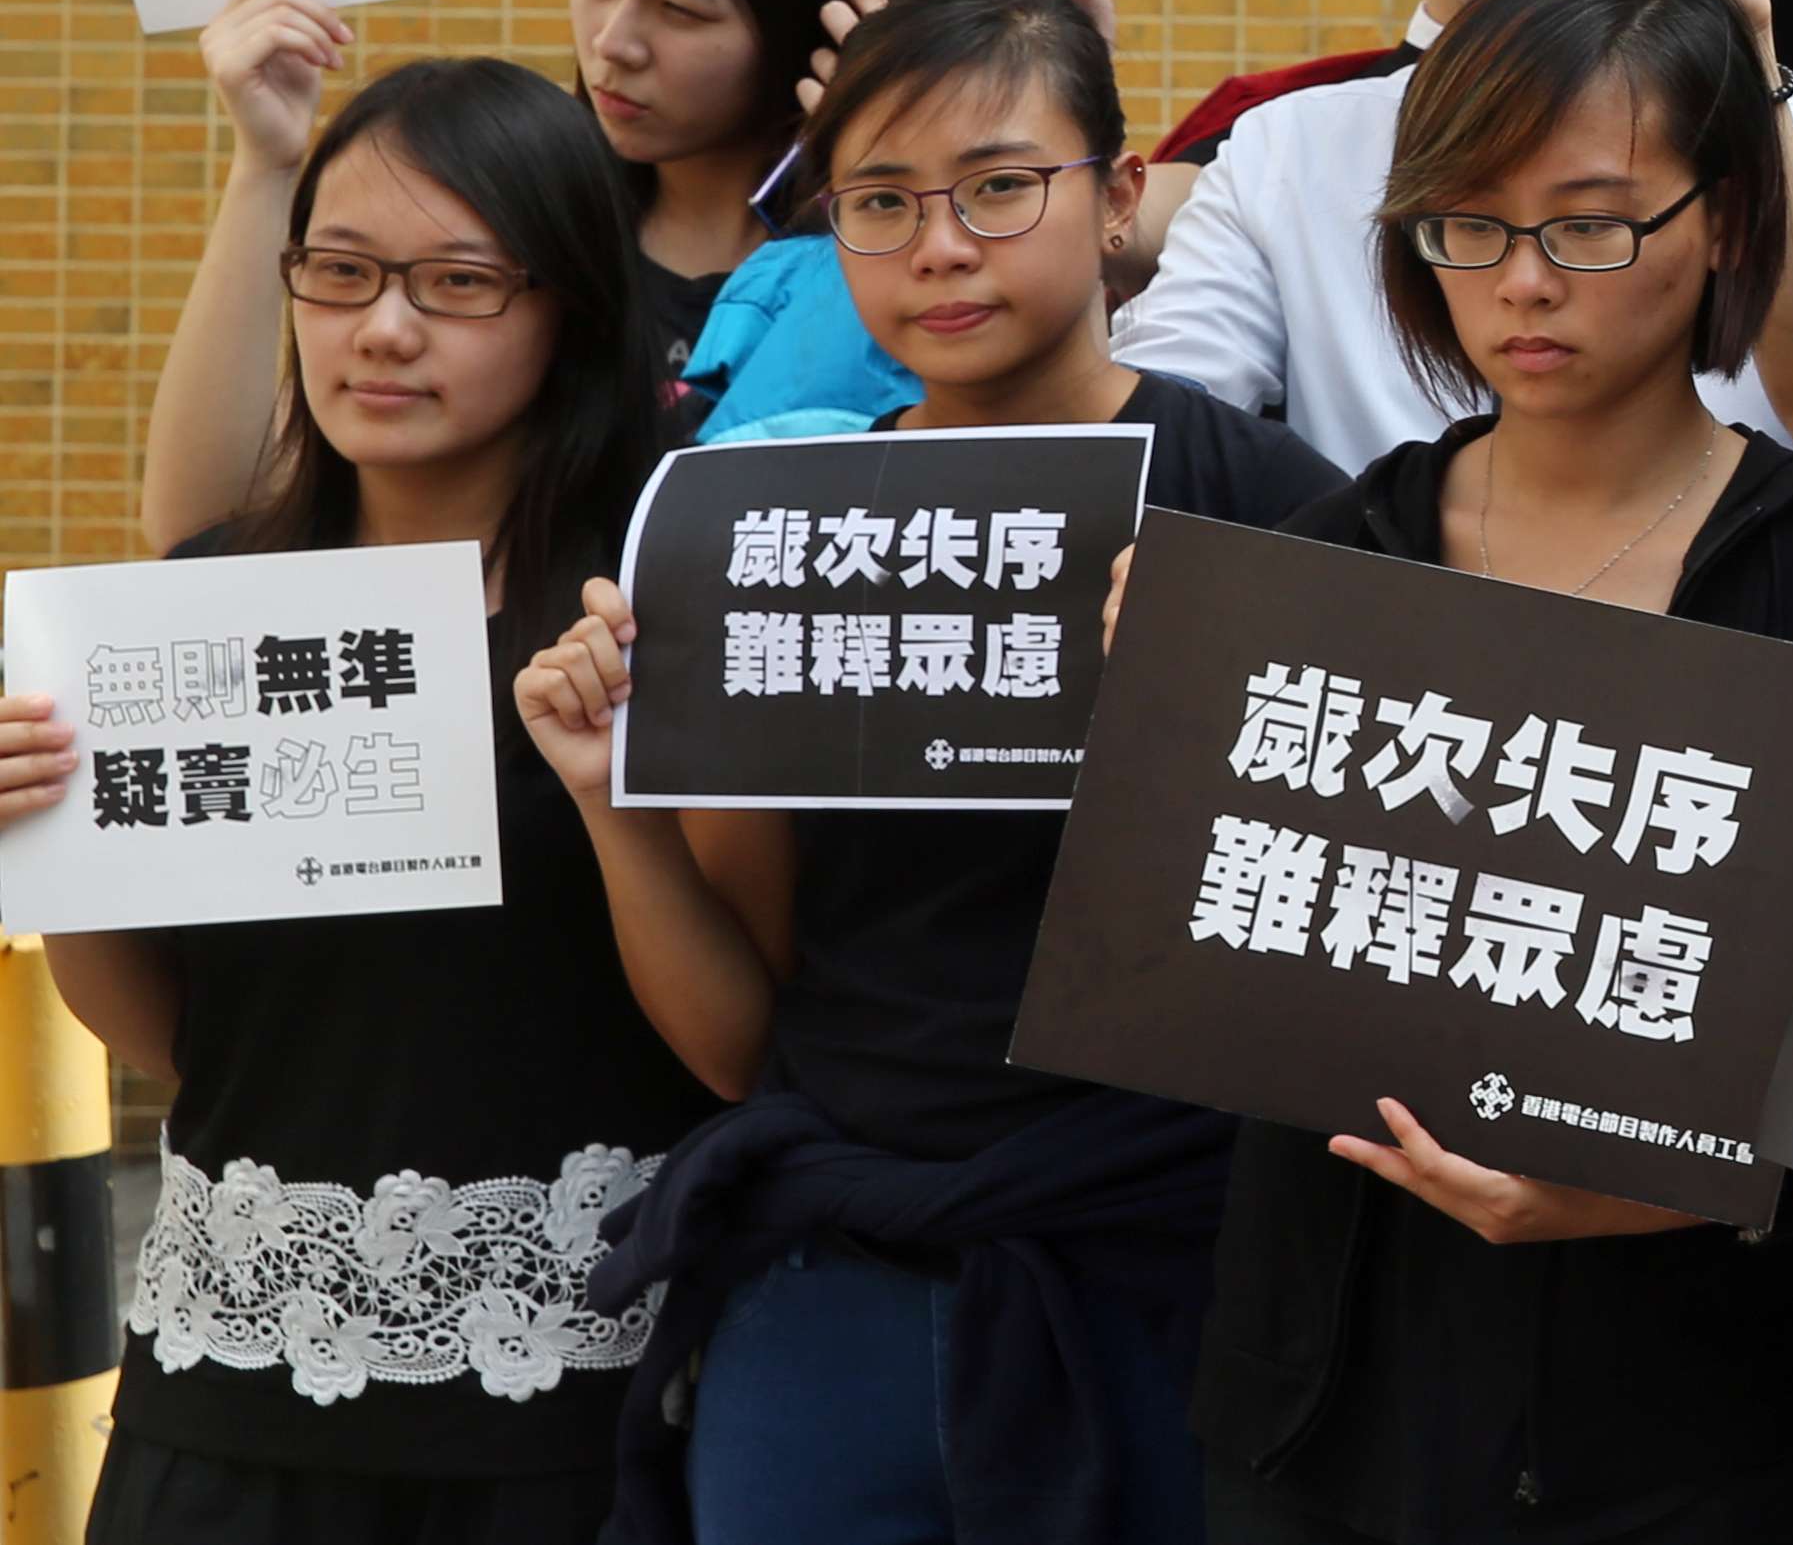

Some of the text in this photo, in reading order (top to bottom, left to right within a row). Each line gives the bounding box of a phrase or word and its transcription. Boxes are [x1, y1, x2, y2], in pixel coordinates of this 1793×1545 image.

[726, 507, 1067, 590] 歲次失序
[87, 628, 417, 728] 無則無準
[722, 611, 1062, 698] 難釋眾慮
[93, 732, 424, 830] 疑竇必生
[1227, 662, 1754, 876] 歲次失序
[1188, 814, 1715, 1044] 難釋眾慮
